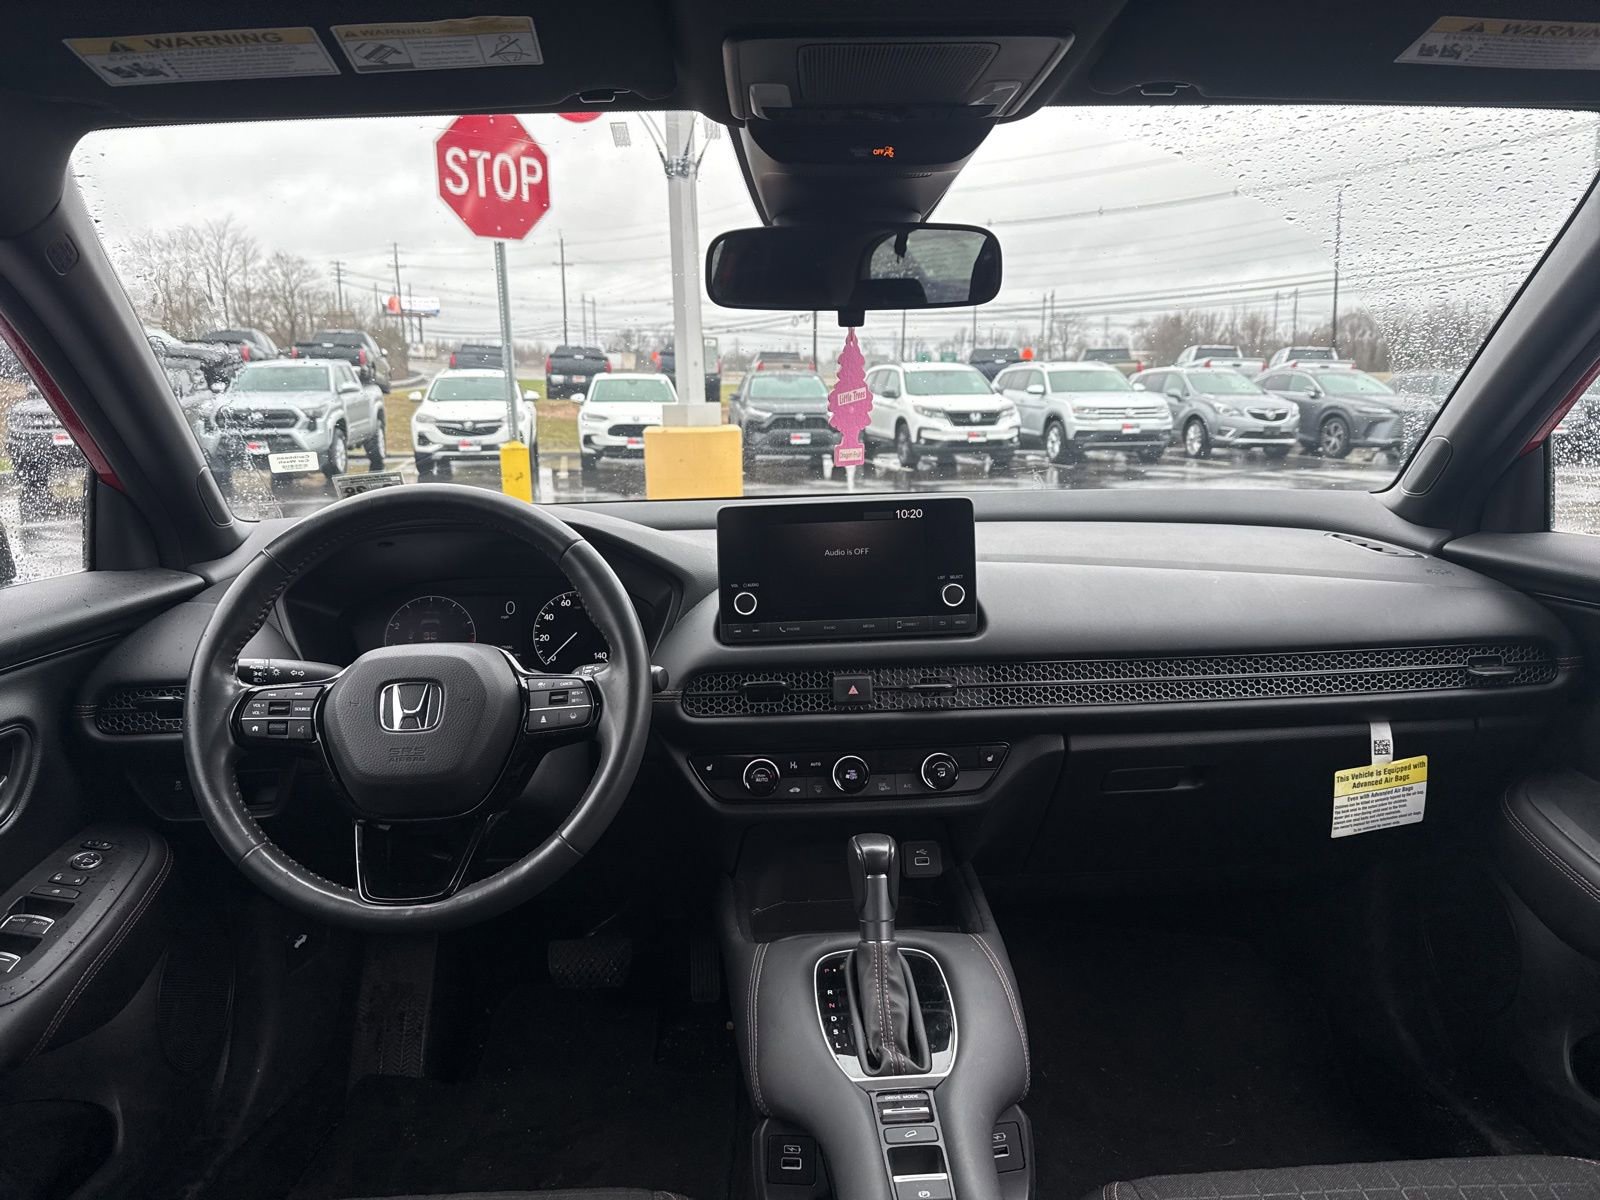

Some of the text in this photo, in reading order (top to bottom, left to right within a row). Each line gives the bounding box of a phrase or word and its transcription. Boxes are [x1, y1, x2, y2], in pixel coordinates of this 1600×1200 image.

[144, 31, 284, 49] WARNING
[445, 147, 543, 202] STOP
[840, 390, 866, 404] Little Trees
[896, 508, 923, 519] 10:20
[824, 548, 870, 556] Audio is OFF
[505, 601, 516, 614] 0
[1336, 775, 1349, 783] This
[1351, 772, 1374, 780] Vehicle
[1384, 764, 1411, 775] Equipped
[1352, 780, 1383, 789] Advanced
[1371, 789, 1393, 798] Advanced
